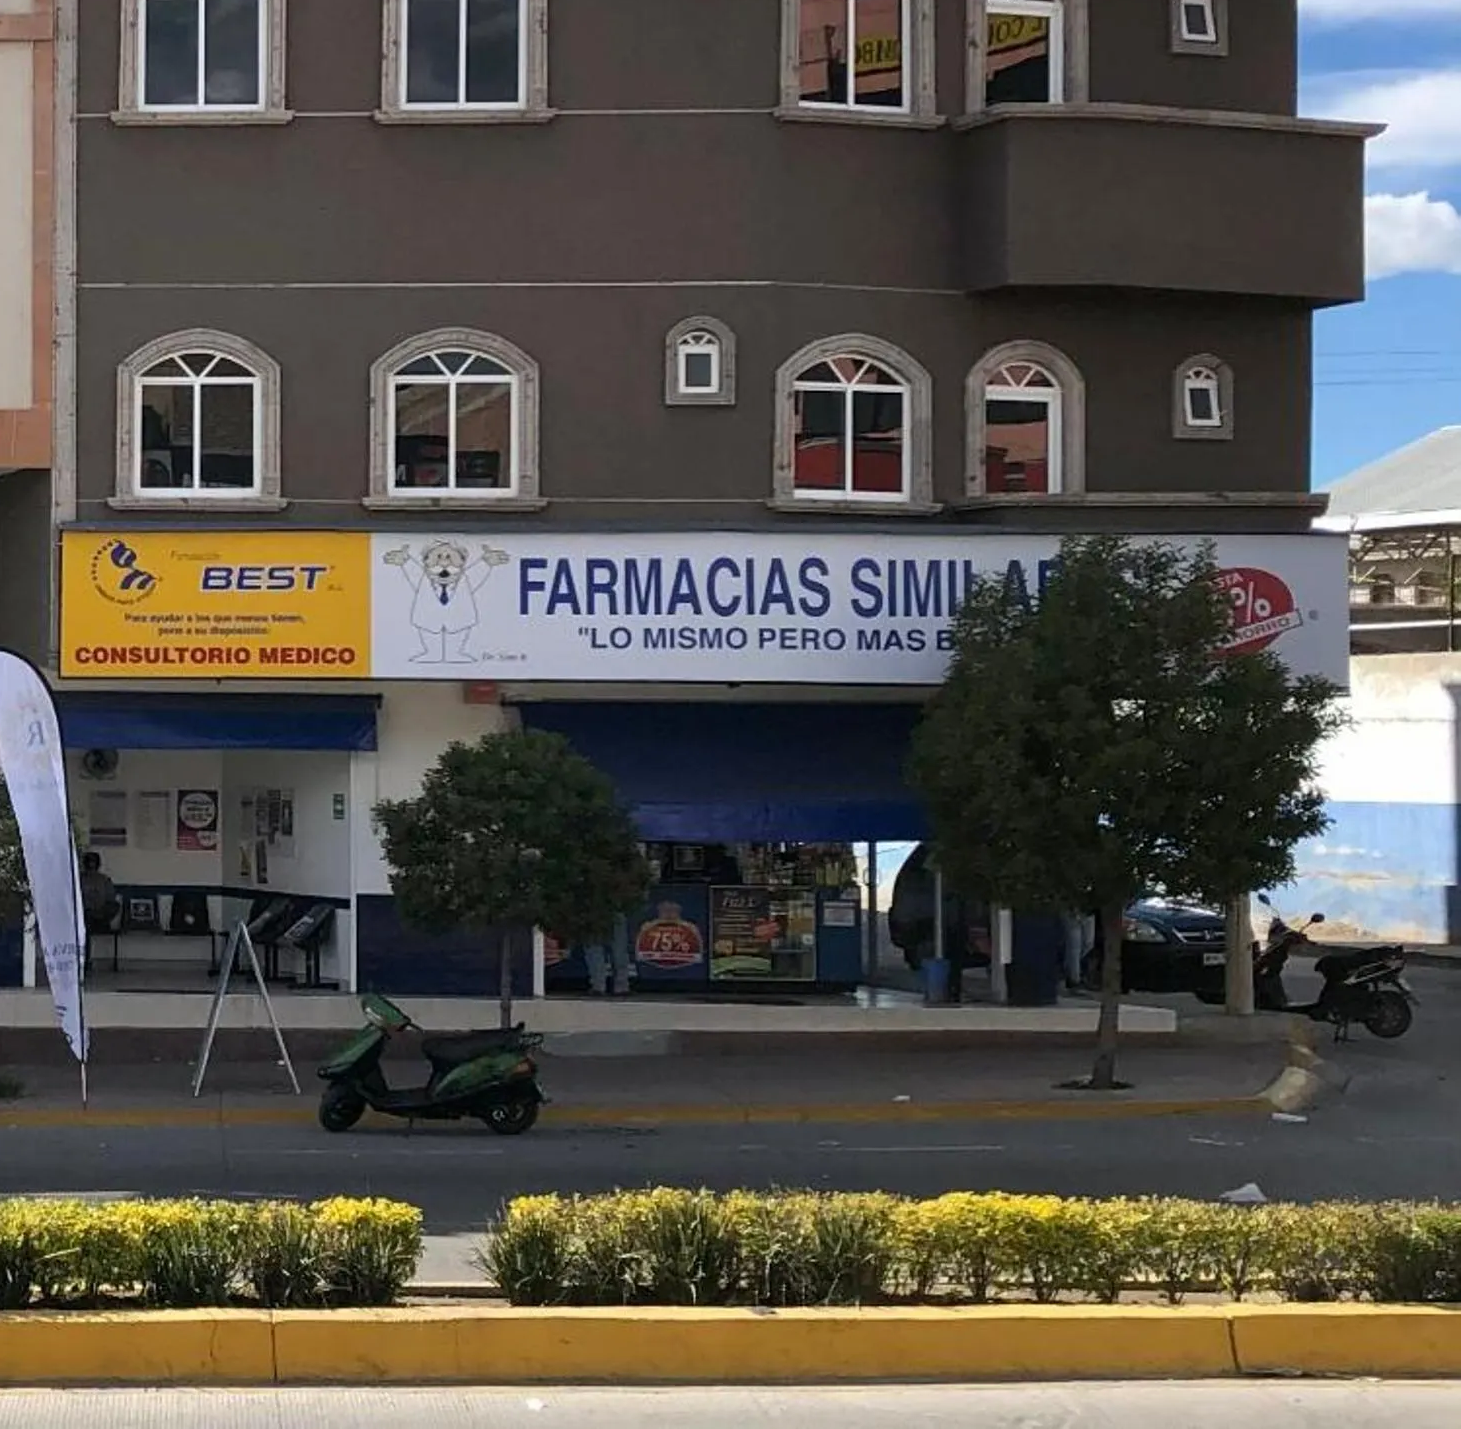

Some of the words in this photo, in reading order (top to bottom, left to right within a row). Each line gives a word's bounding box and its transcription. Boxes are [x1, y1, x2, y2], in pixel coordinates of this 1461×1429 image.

[201, 565, 327, 591] BEST
[519, 556, 831, 618] FARMACIAS
[578, 627, 633, 649] "LO
[644, 626, 748, 650] MISMO
[758, 627, 847, 651] PERO
[857, 628, 927, 652] MAS
[75, 646, 251, 665] CONSULTORIO
[259, 646, 356, 665] MEDICO
[647, 931, 691, 953] 75%
